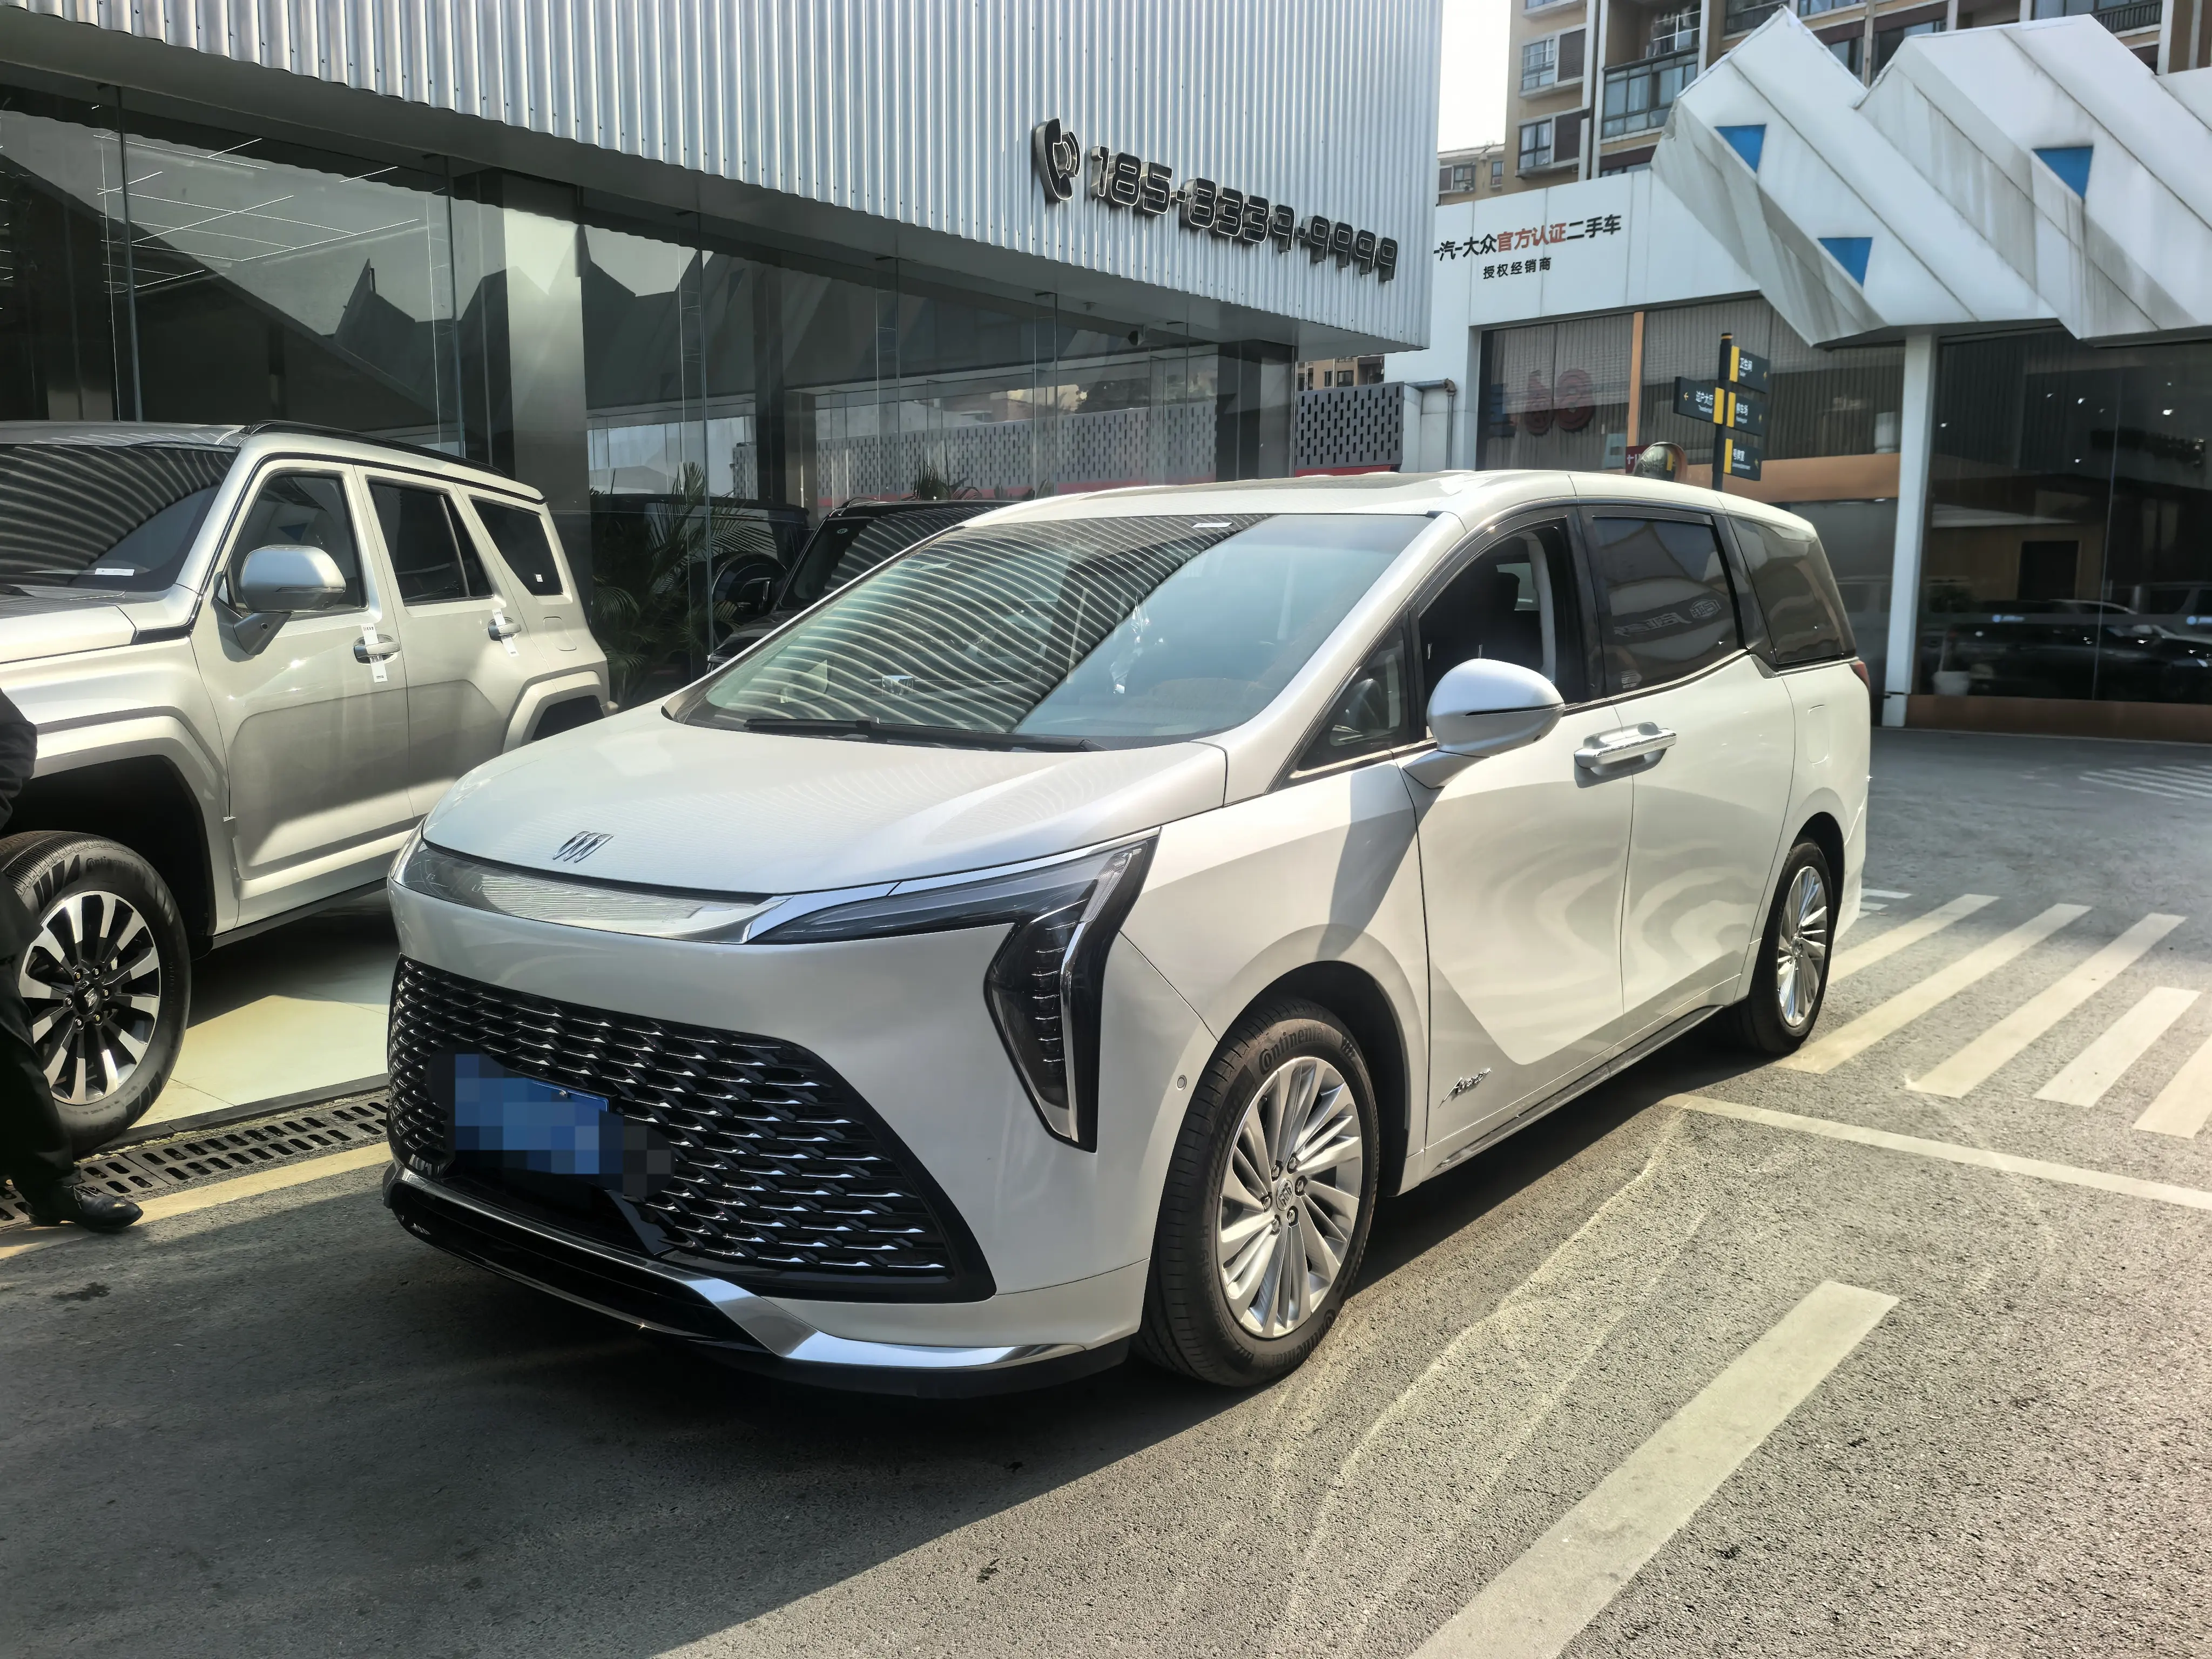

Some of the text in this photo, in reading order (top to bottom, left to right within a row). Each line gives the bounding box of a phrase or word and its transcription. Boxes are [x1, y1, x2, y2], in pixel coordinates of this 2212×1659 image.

[1482, 257, 1552, 280] 授权经销商
